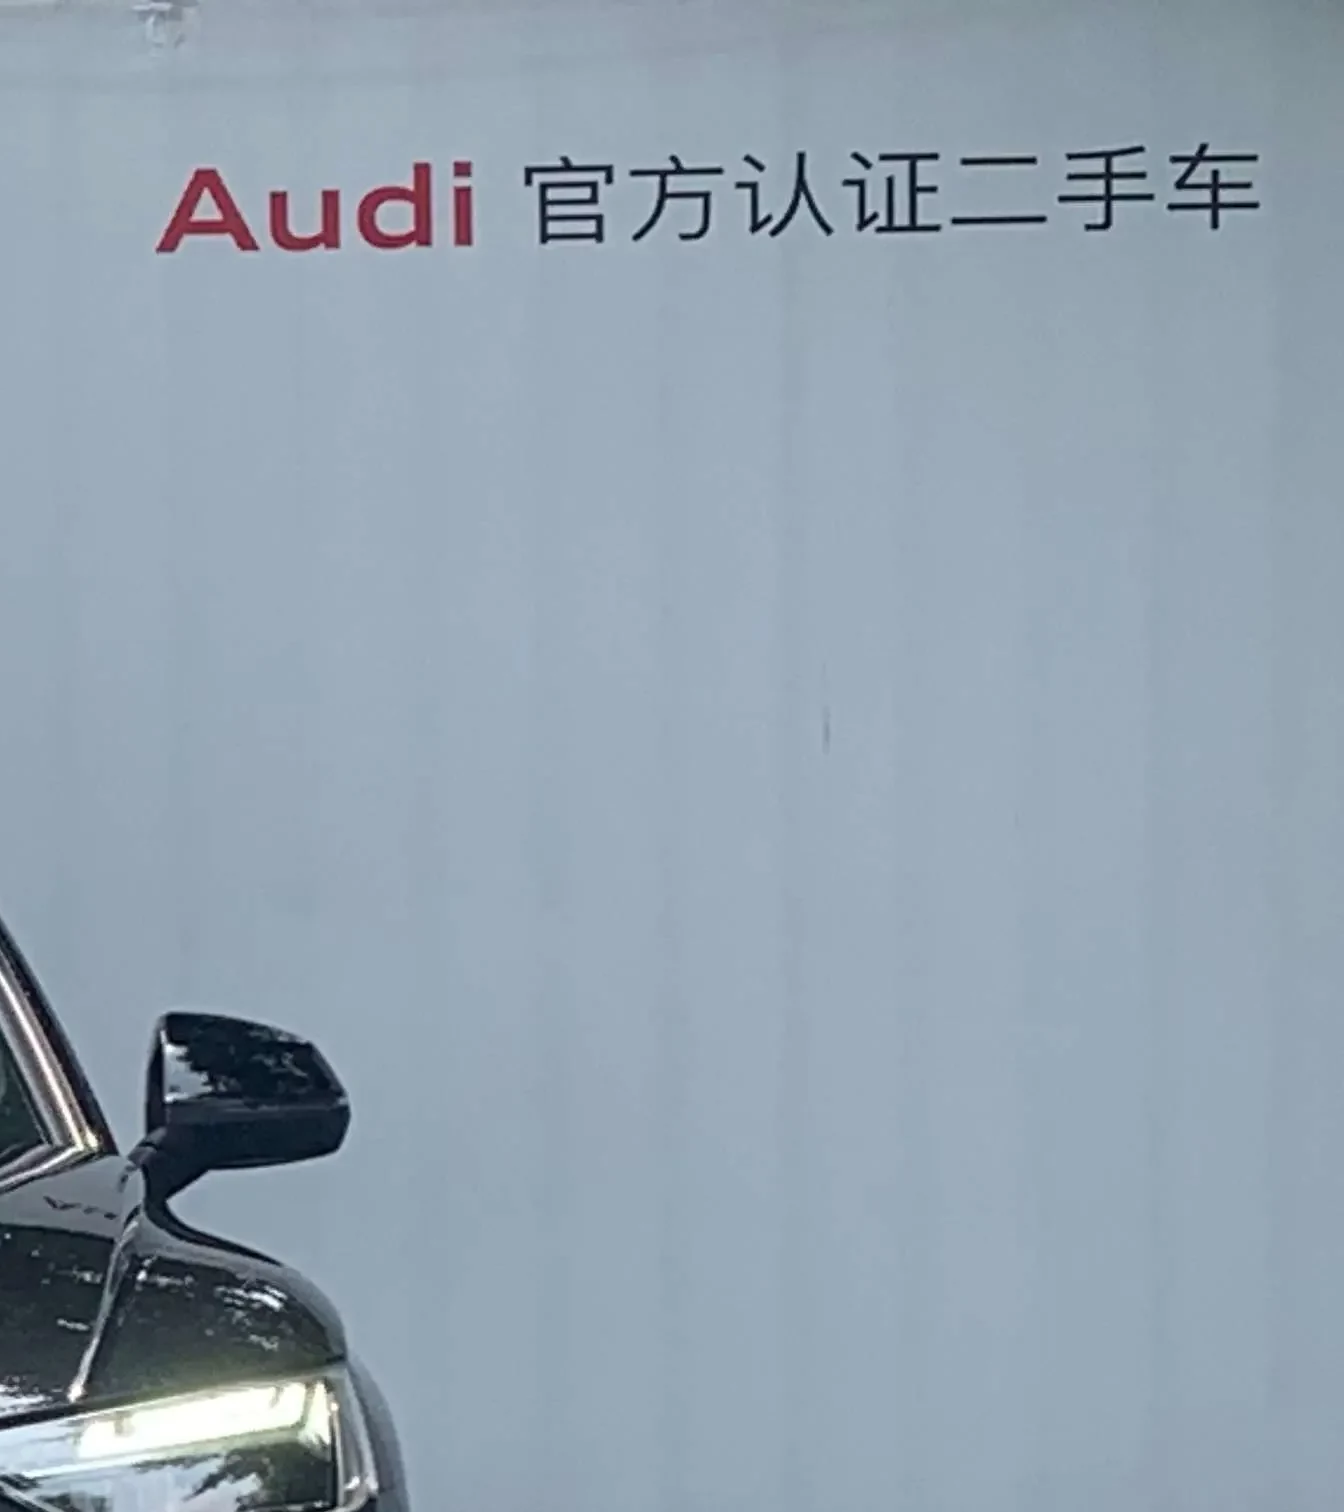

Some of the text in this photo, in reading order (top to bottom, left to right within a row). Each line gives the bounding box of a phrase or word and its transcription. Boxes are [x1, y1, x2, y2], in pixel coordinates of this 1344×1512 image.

[155, 142, 1261, 254] Audi 官方认证二手车
